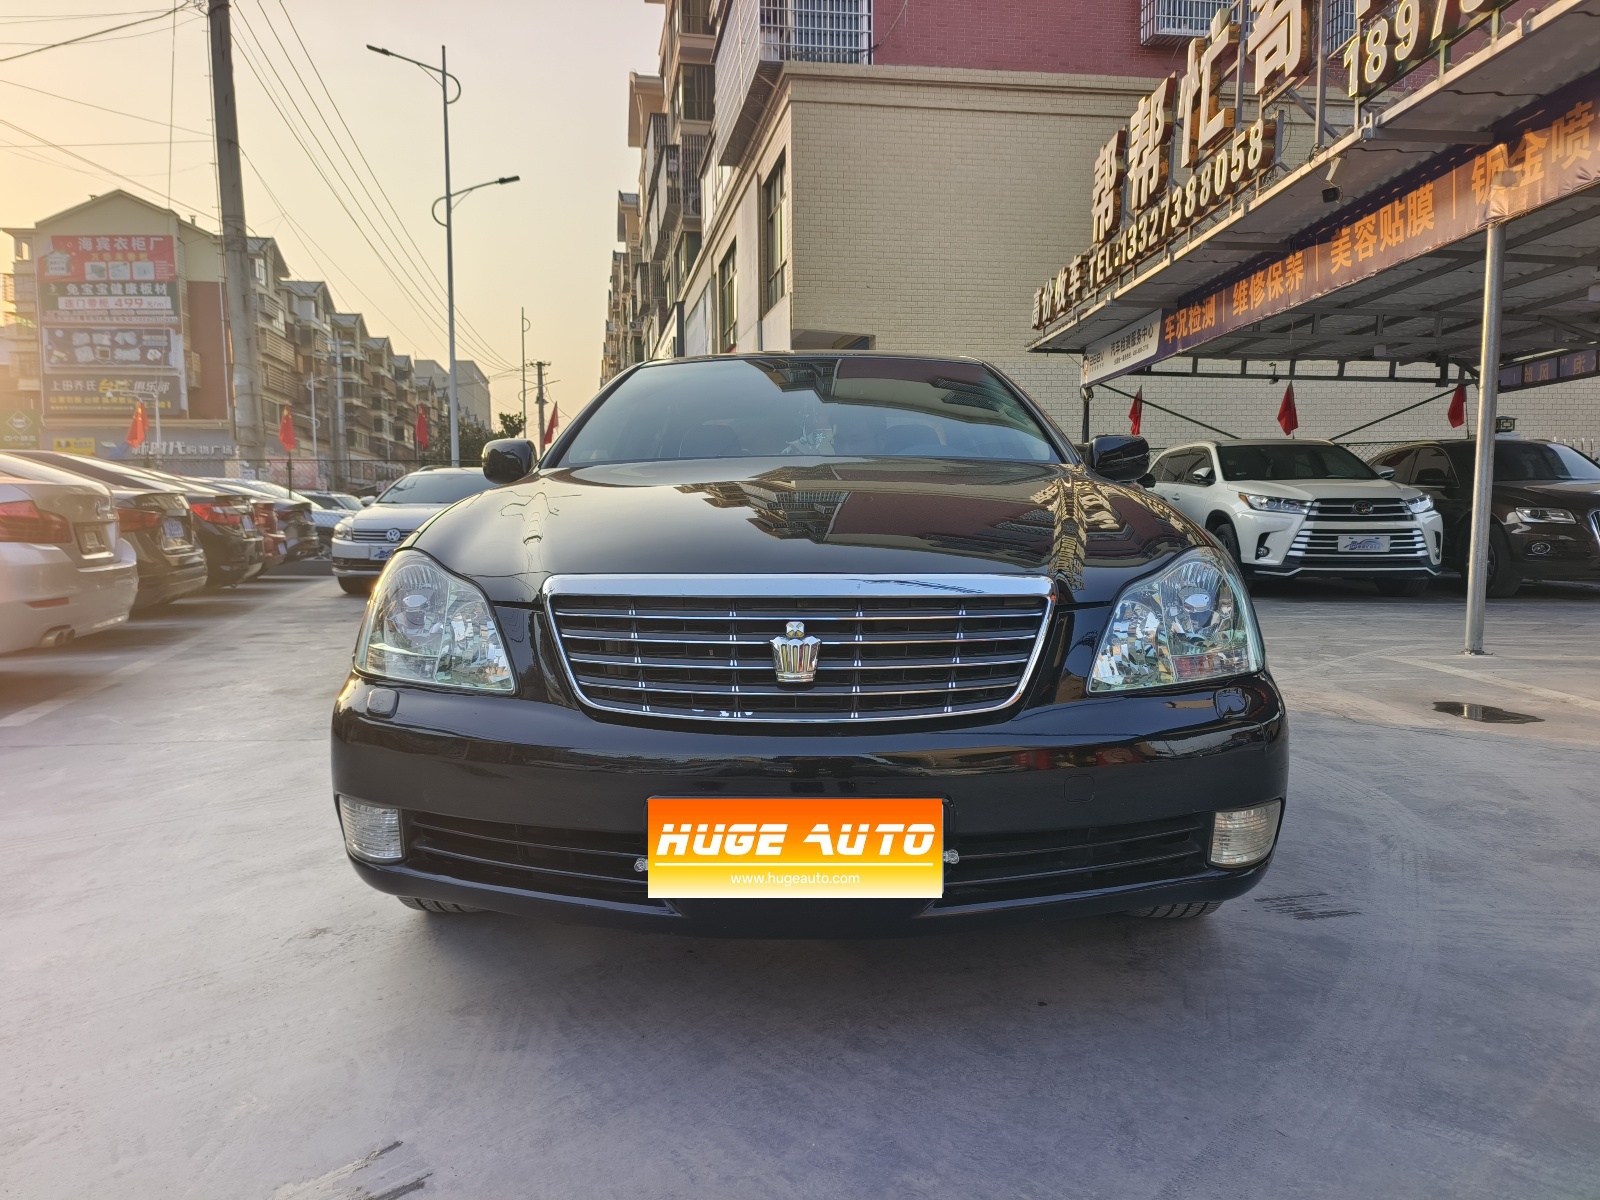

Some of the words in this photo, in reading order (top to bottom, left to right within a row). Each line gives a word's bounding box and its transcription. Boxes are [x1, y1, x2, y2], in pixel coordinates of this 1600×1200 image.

[1343, 0, 1486, 98] 1897
[1031, 255, 1085, 330] 高价收车
[1088, 119, 1266, 289] TEL:13327388058
[1164, 292, 1216, 345] 车况检测
[1232, 252, 1304, 317] 维修保养
[1330, 182, 1435, 275] 美容贴膜
[1471, 100, 1599, 207] 钣金喷
[66, 283, 167, 296] 兔宝宝健康板材
[114, 298, 144, 309] 499
